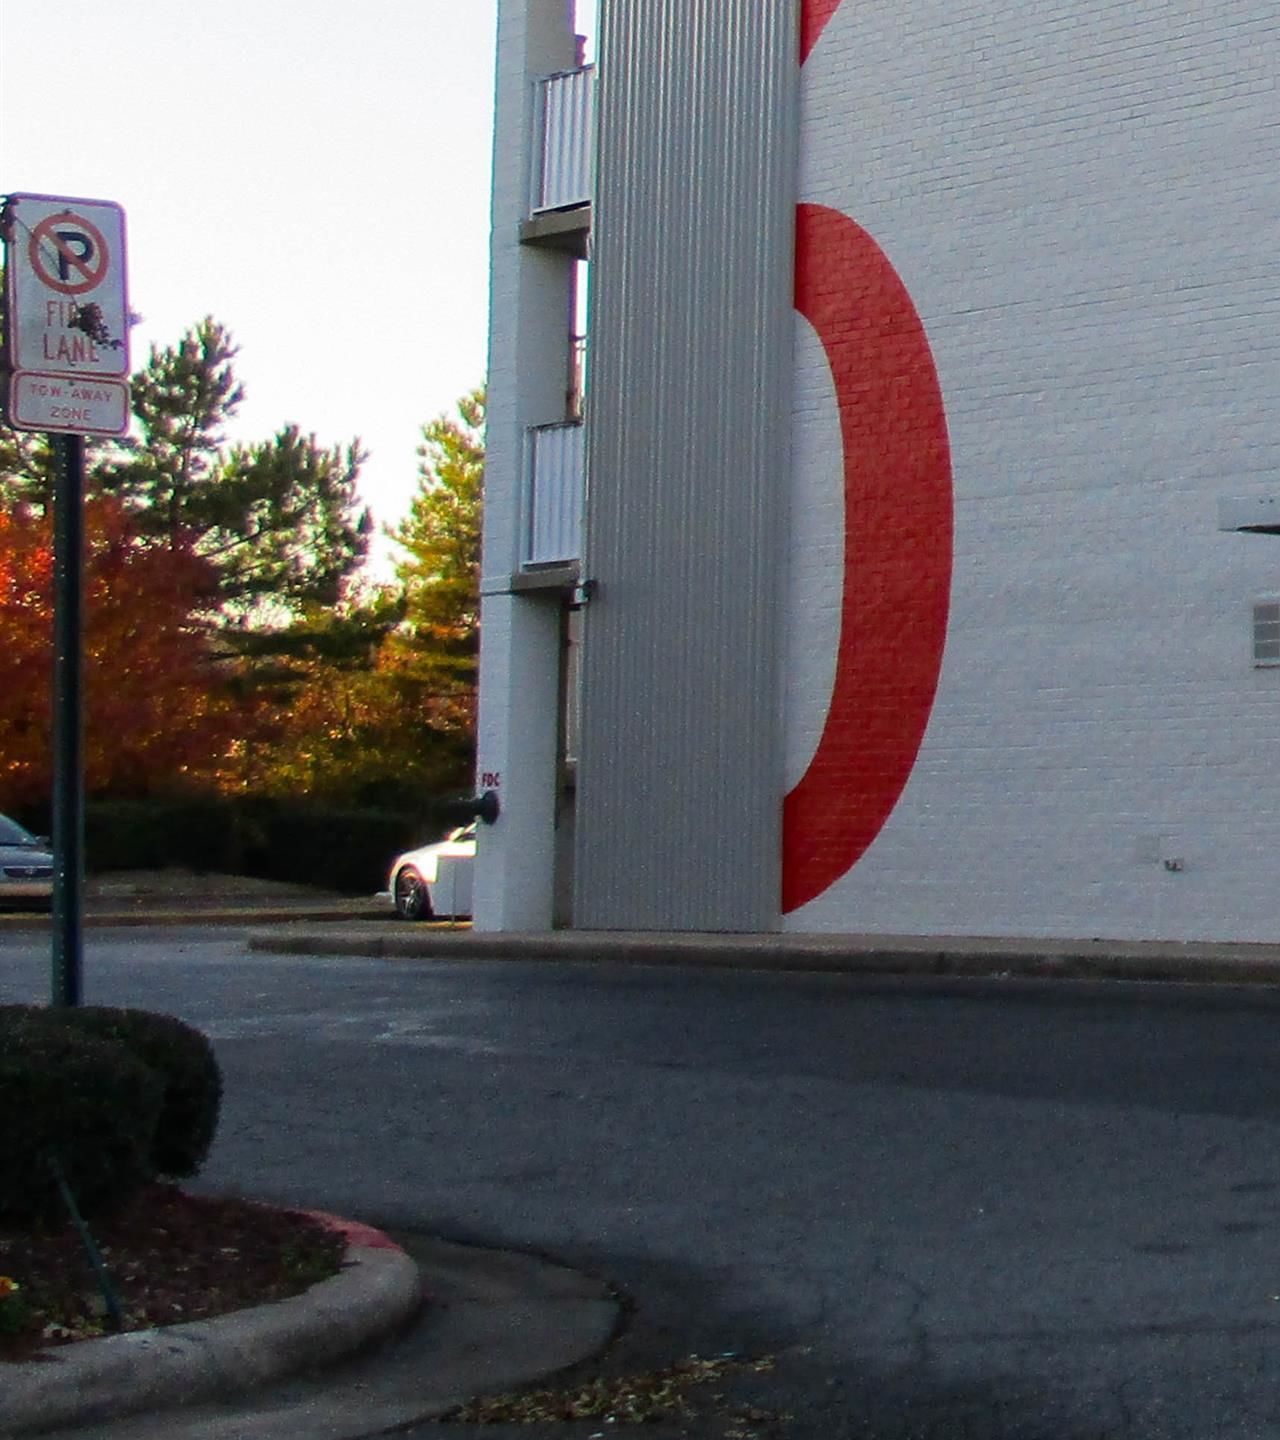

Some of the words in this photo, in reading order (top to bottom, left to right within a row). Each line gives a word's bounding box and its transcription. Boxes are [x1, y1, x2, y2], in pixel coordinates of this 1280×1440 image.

[46, 300, 103, 328] FI
[43, 333, 99, 362] LANE
[50, 406, 92, 420] ZONE
[482, 772, 500, 787] FDC
